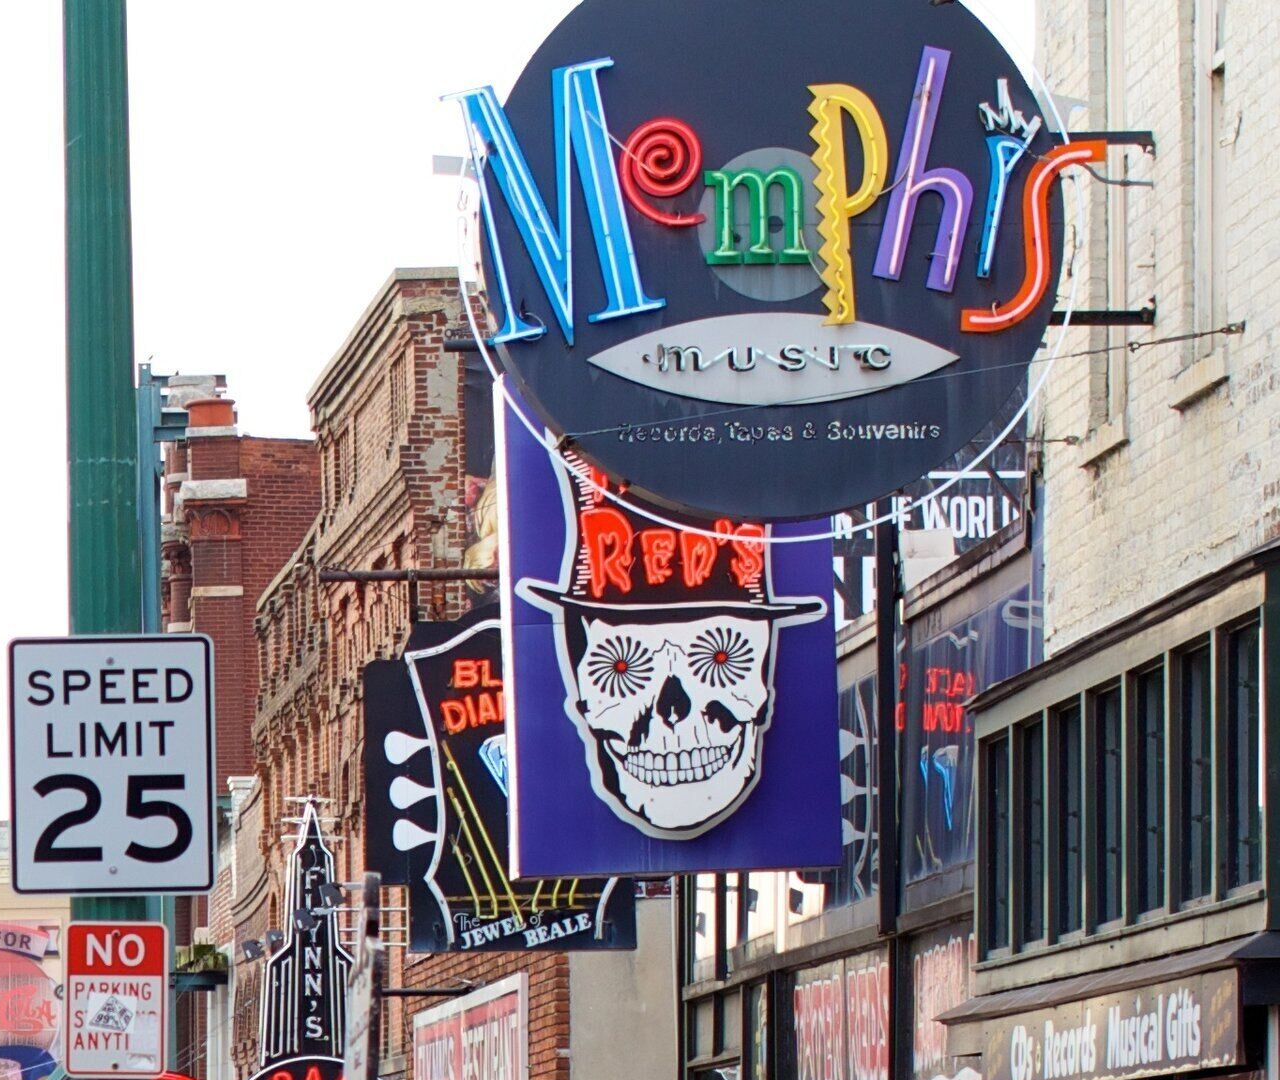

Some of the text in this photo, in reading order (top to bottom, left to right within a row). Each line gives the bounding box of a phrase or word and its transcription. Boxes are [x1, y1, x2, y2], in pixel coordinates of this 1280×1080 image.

[647, 341, 893, 375] music
[802, 423, 816, 440] &
[827, 421, 940, 440] Souvenirs
[27, 668, 195, 706] SPEED
[453, 660, 503, 688] BL
[45, 721, 176, 758] LIMIT
[32, 774, 194, 863] 25
[454, 911, 592, 949] The JEWEL of BEALE
[86, 933, 145, 967] NO
[74, 982, 152, 1000] PARKING
[73, 1033, 130, 1051] ANYTI
[1043, 1008, 1097, 1080] Records
[1106, 995, 1163, 1069] Musical
[1165, 987, 1201, 1060] Gifts
